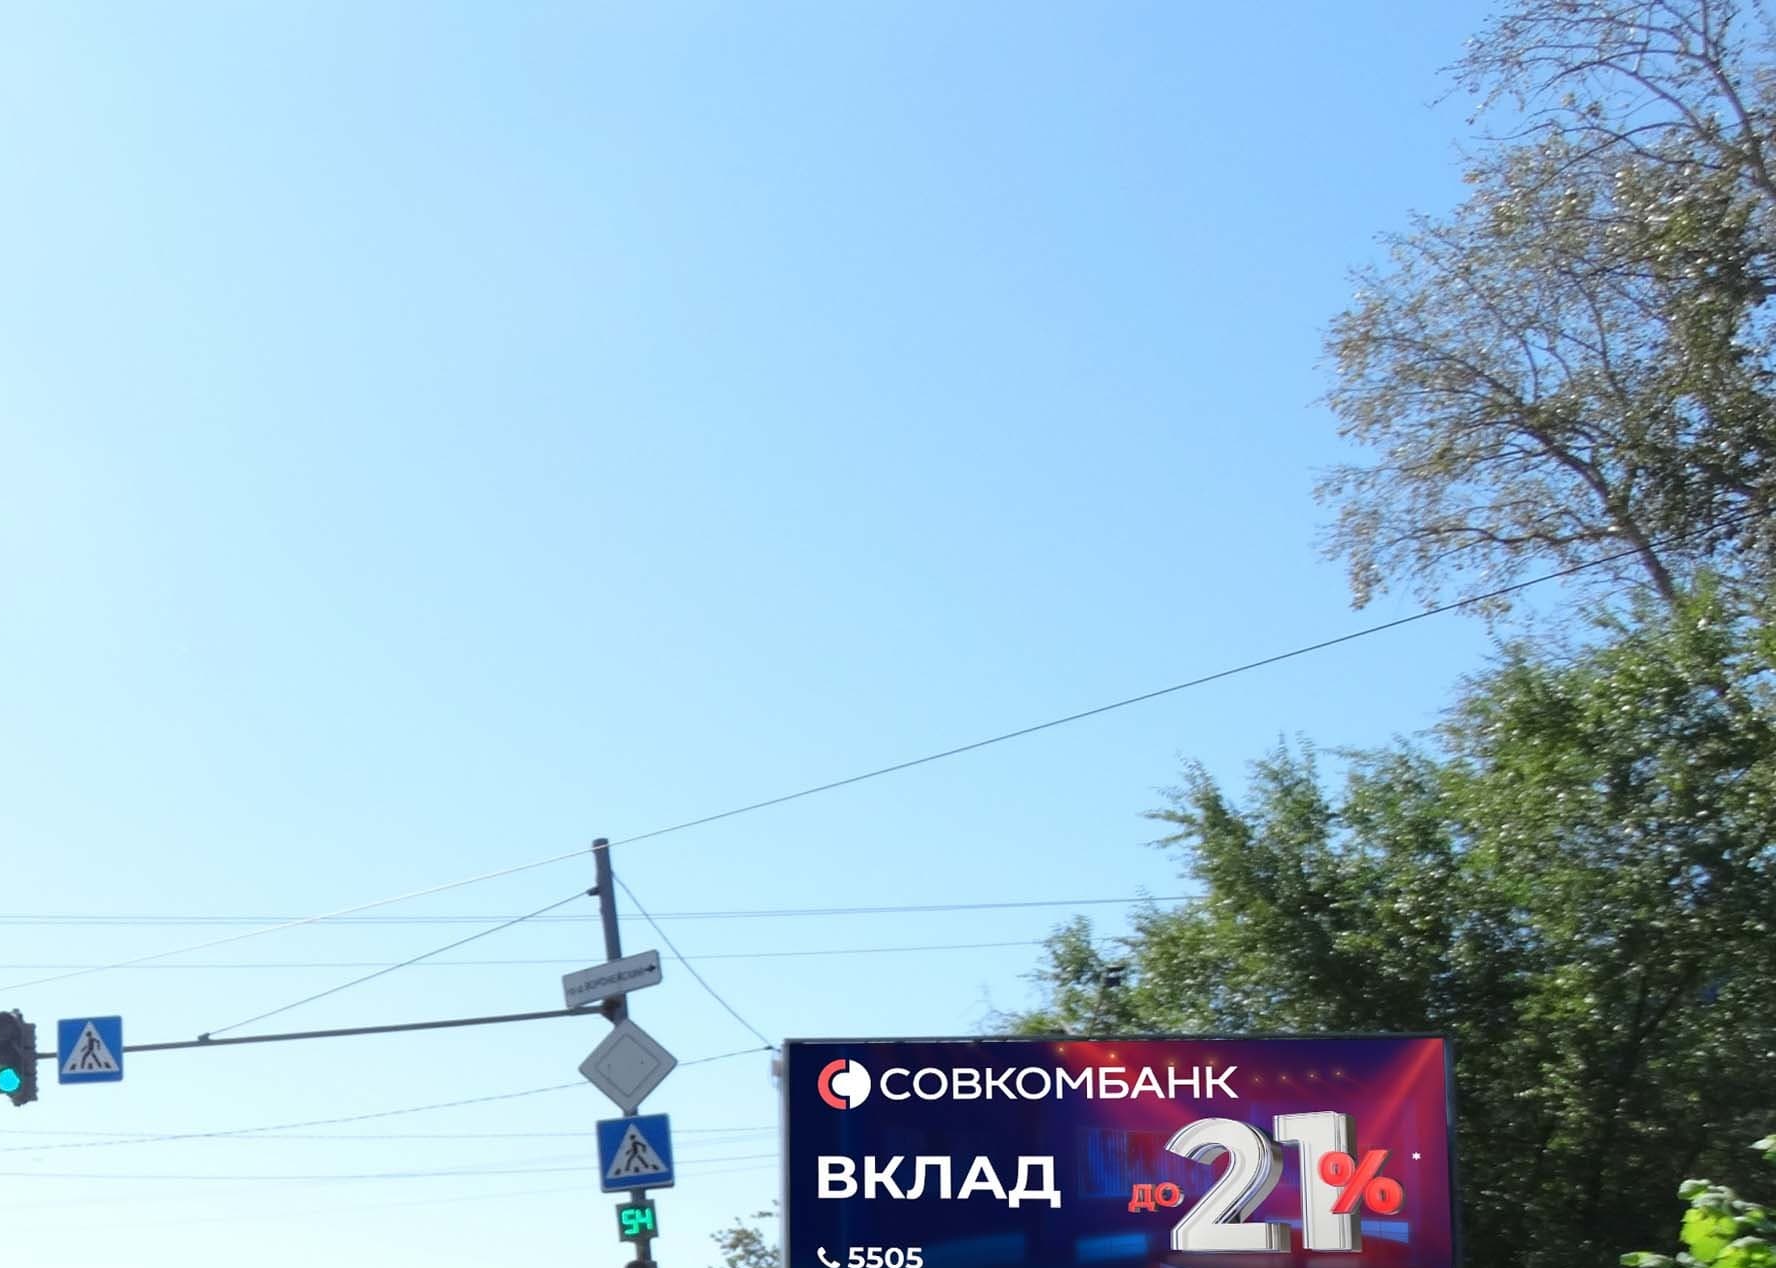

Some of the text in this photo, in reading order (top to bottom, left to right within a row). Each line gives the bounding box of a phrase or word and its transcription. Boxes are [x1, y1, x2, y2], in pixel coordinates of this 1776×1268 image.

[880, 1066, 1239, 1101] СОВКОМБАНК
[816, 1155, 1062, 1208] ВКЛАД
[622, 1207, 653, 1234] 54
